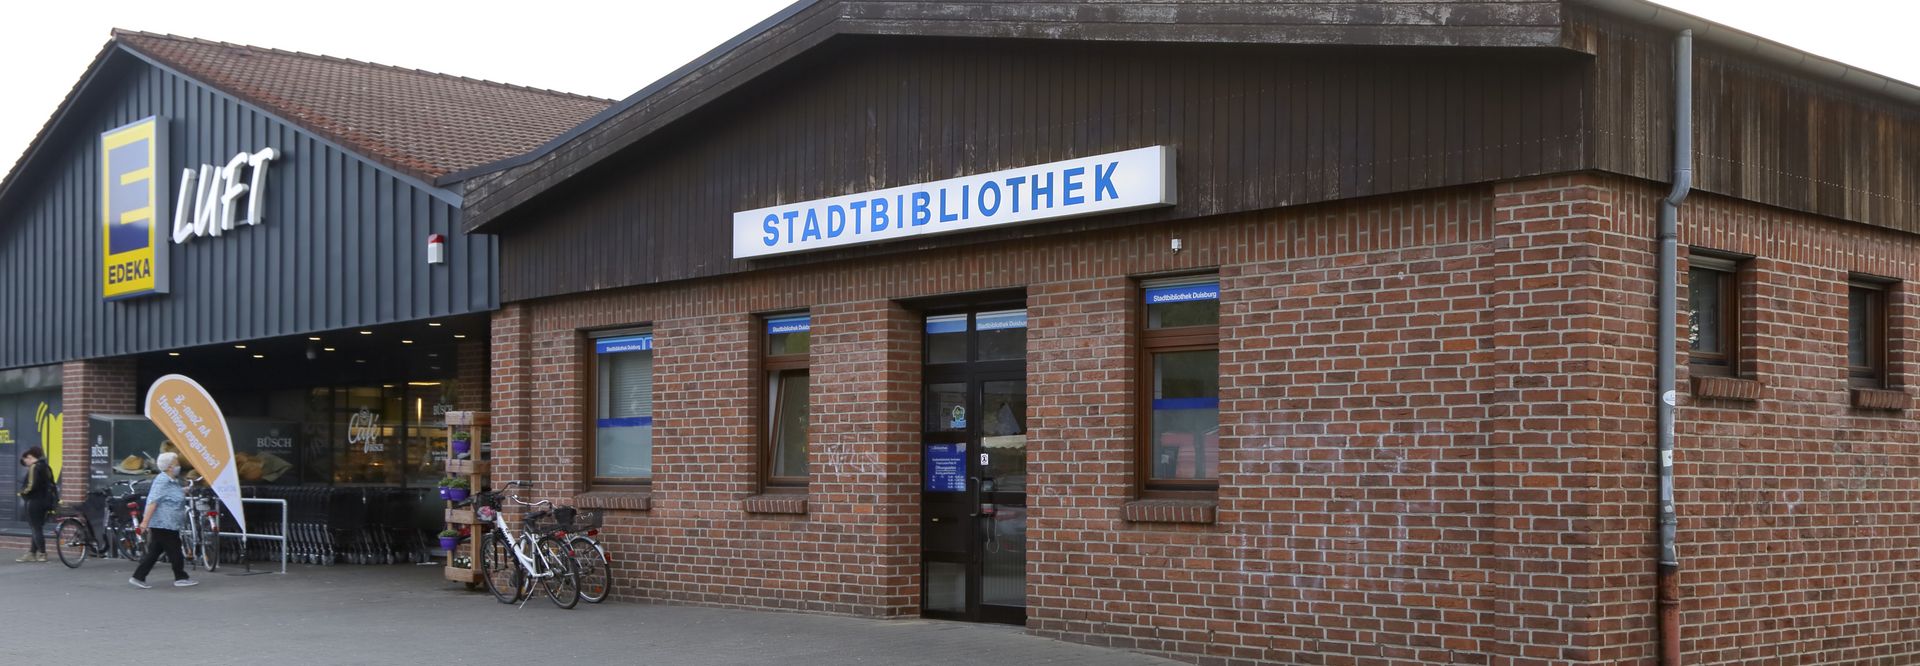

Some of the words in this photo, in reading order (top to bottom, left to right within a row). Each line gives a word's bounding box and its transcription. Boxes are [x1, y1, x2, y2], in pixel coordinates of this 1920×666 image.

[172, 147, 280, 244] LUFT
[762, 161, 1120, 247] STADTBIBLIOTHEK
[108, 257, 150, 285] EDEKA
[1153, 292, 1192, 302] Stadtbibliothek
[1192, 291, 1217, 299] Duisburg
[256, 436, 292, 448] BÜSCH
[348, 413, 380, 454] Café
